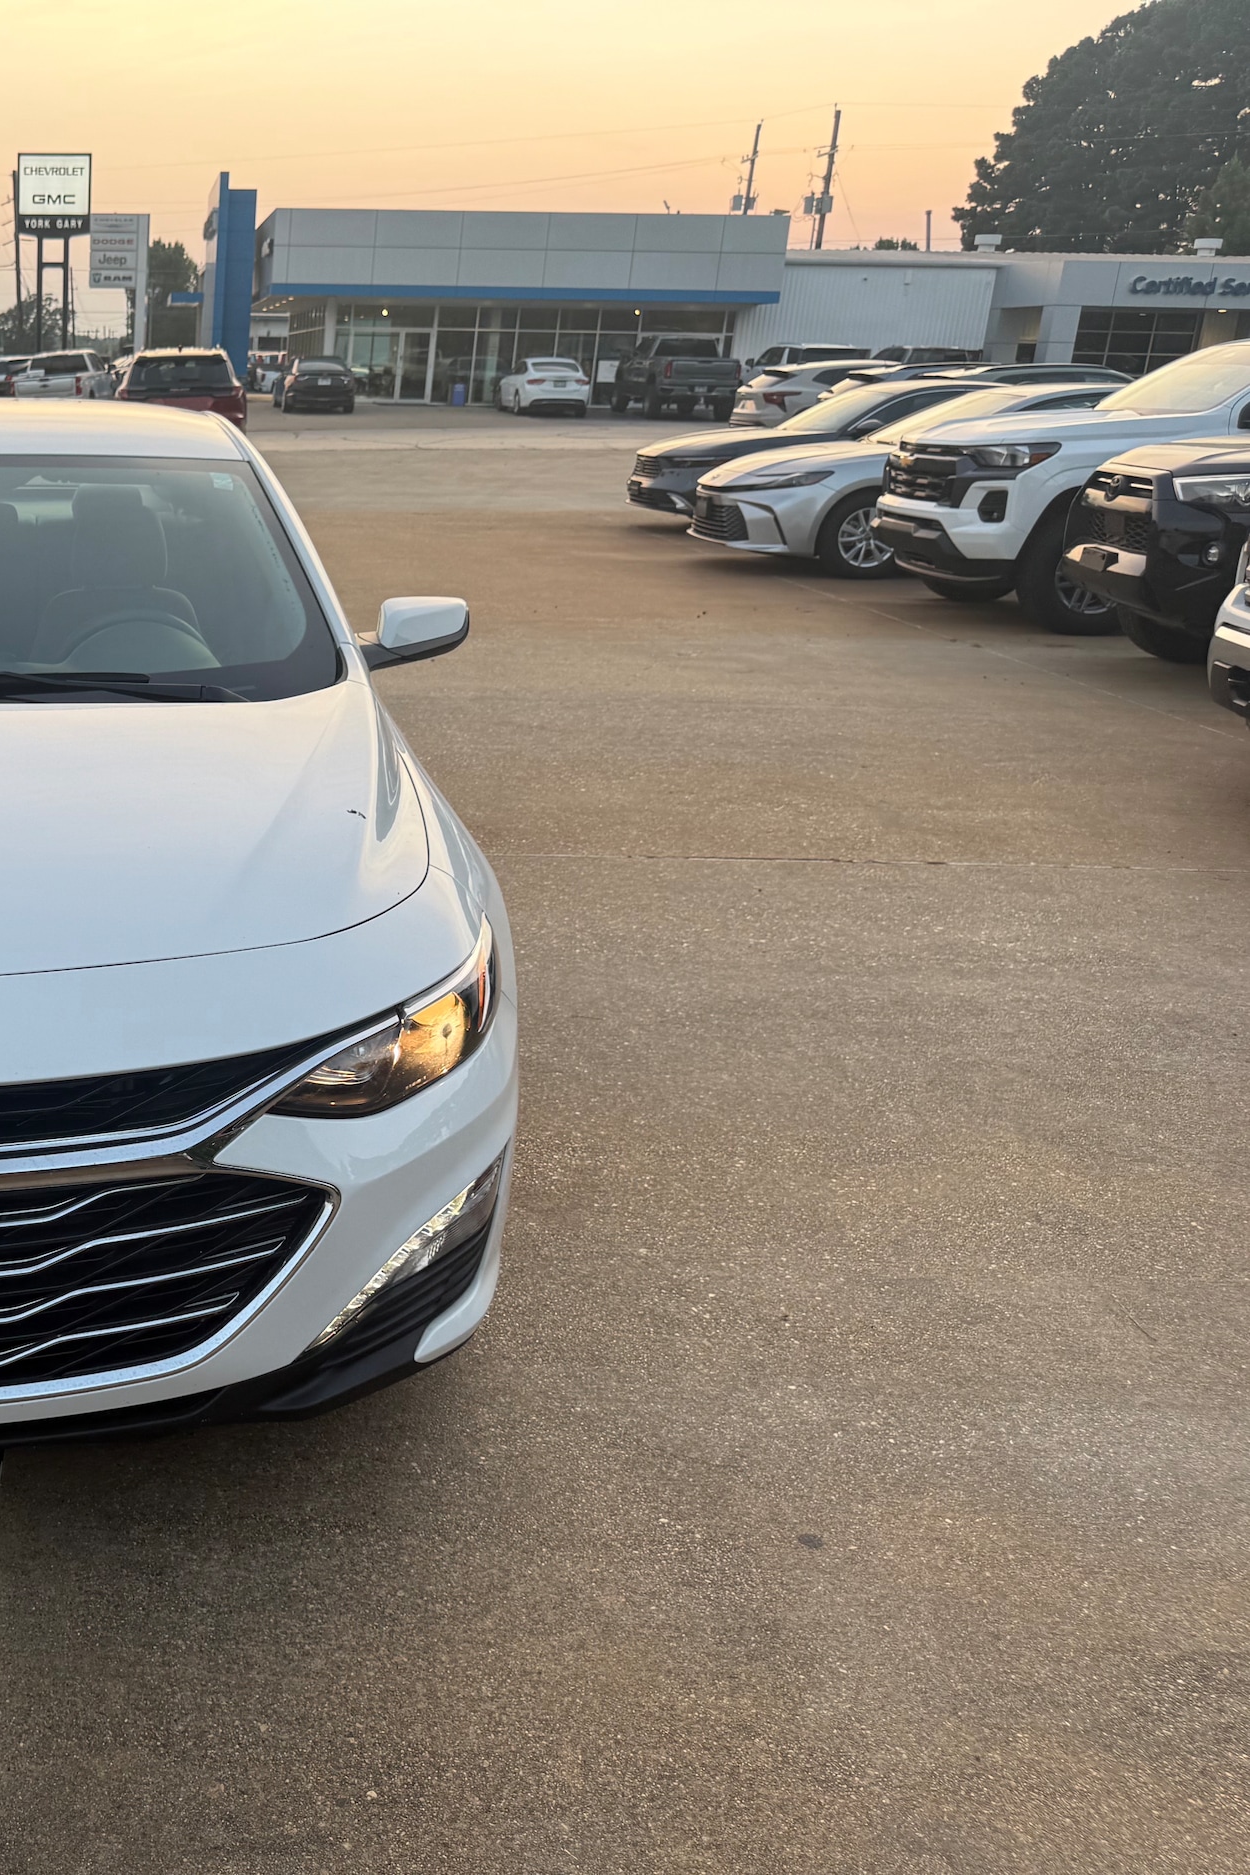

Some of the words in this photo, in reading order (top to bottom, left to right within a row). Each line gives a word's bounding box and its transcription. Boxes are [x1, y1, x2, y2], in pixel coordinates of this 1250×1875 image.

[23, 166, 85, 176] CHEVROLET
[32, 194, 76, 205] GMC
[24, 218, 51, 229] YORK
[56, 218, 83, 229] GARY
[98, 253, 127, 267] Jeep
[1130, 276, 1218, 295] Certified
